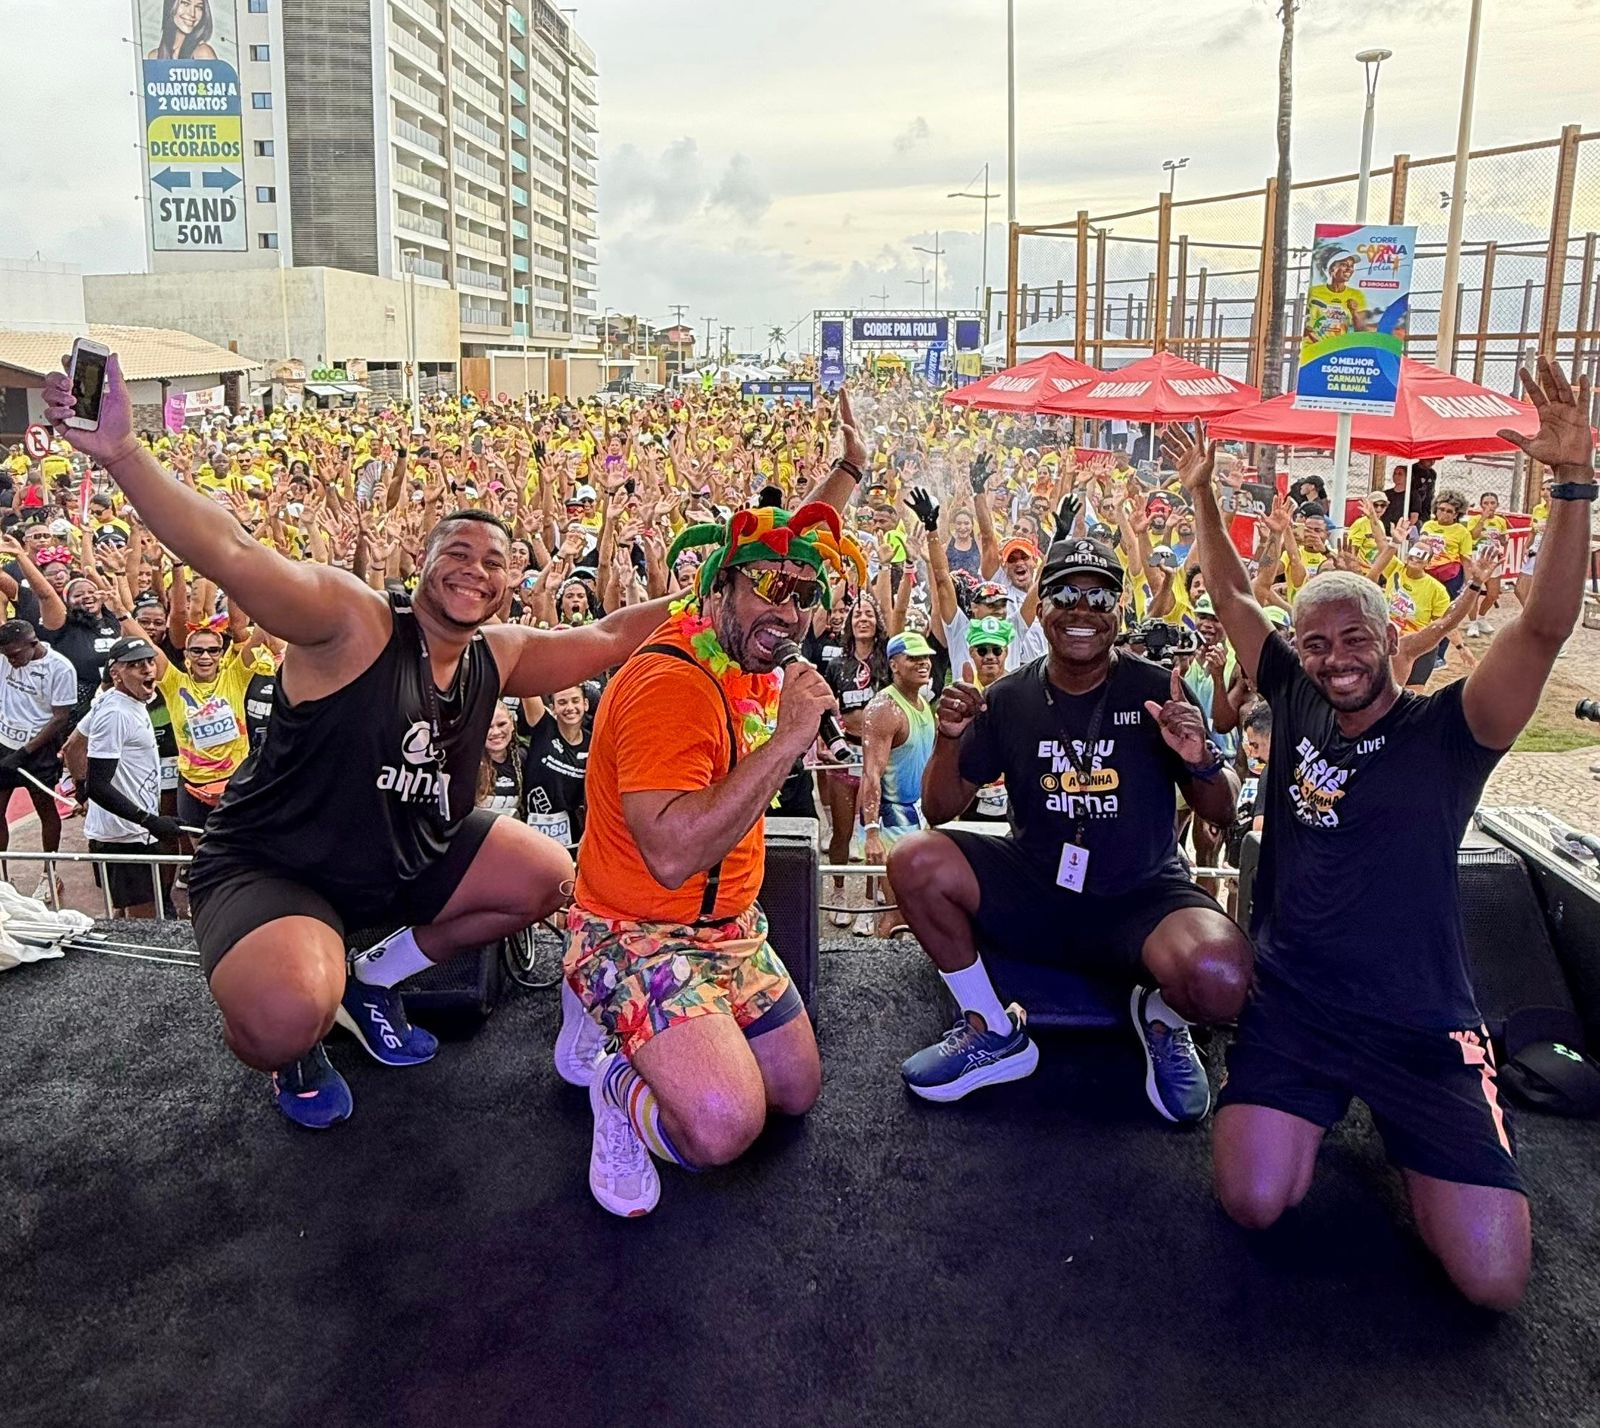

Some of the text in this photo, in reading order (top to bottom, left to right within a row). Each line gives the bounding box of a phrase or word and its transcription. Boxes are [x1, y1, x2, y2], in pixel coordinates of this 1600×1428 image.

[169, 68, 213, 81] STUDIO
[158, 97, 228, 111] 2 QUARTOS
[171, 124, 217, 140] VISITE
[150, 141, 240, 156] DECORADOS
[160, 197, 236, 222] STAND
[177, 224, 223, 244] 50M
[863, 321, 938, 337] CORRE PRA FOLIA
[1330, 356, 1374, 367] O MELHOR
[1321, 365, 1380, 376] ESQUENTA DO
[1167, 376, 1239, 397] BRAHMA
[1327, 374, 1372, 384] CARNAVAL
[1327, 383, 1340, 391] DA
[1087, 381, 1152, 398] BRAHMA
[1418, 394, 1522, 418] BRAHMA
[1065, 553, 1107, 568] alpha
[1114, 711, 1141, 725] LIVE!
[0, 723, 26, 740] 150
[194, 718, 234, 740] 1902
[1038, 740, 1066, 758] EU
[1356, 735, 1385, 754] LIVE!
